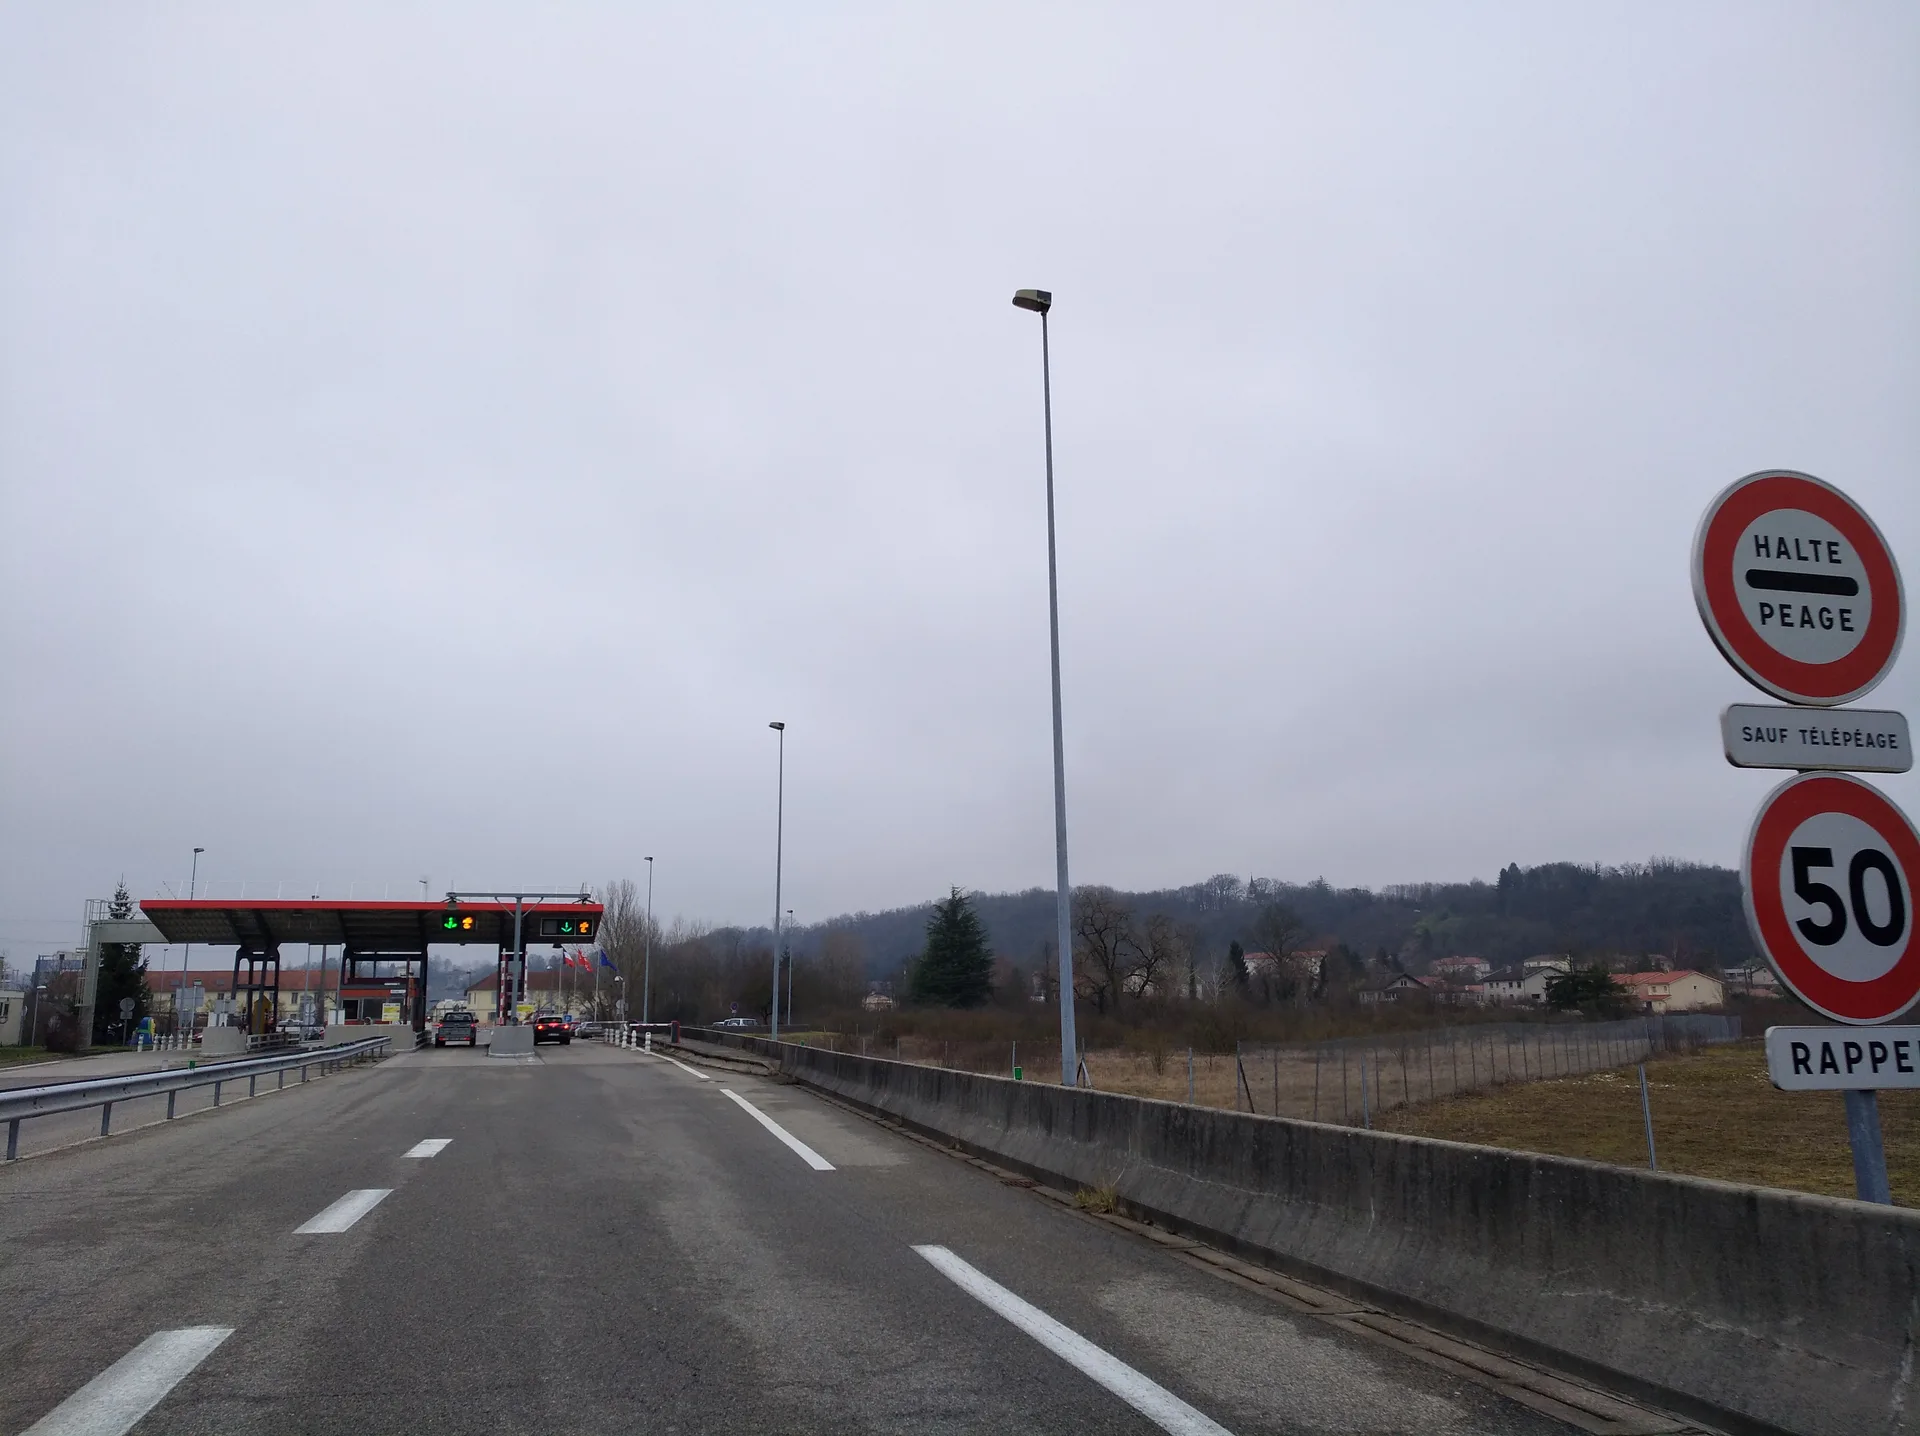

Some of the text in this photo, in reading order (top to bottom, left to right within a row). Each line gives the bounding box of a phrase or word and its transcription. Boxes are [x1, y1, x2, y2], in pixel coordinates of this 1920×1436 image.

[1754, 534, 1842, 564] HALTE
[1759, 602, 1855, 632] PEAGE
[1742, 726, 1899, 749] SAUF TÉLÉPÉAGE
[1791, 846, 1905, 947] 50
[1791, 1040, 1920, 1075] RAPPE
